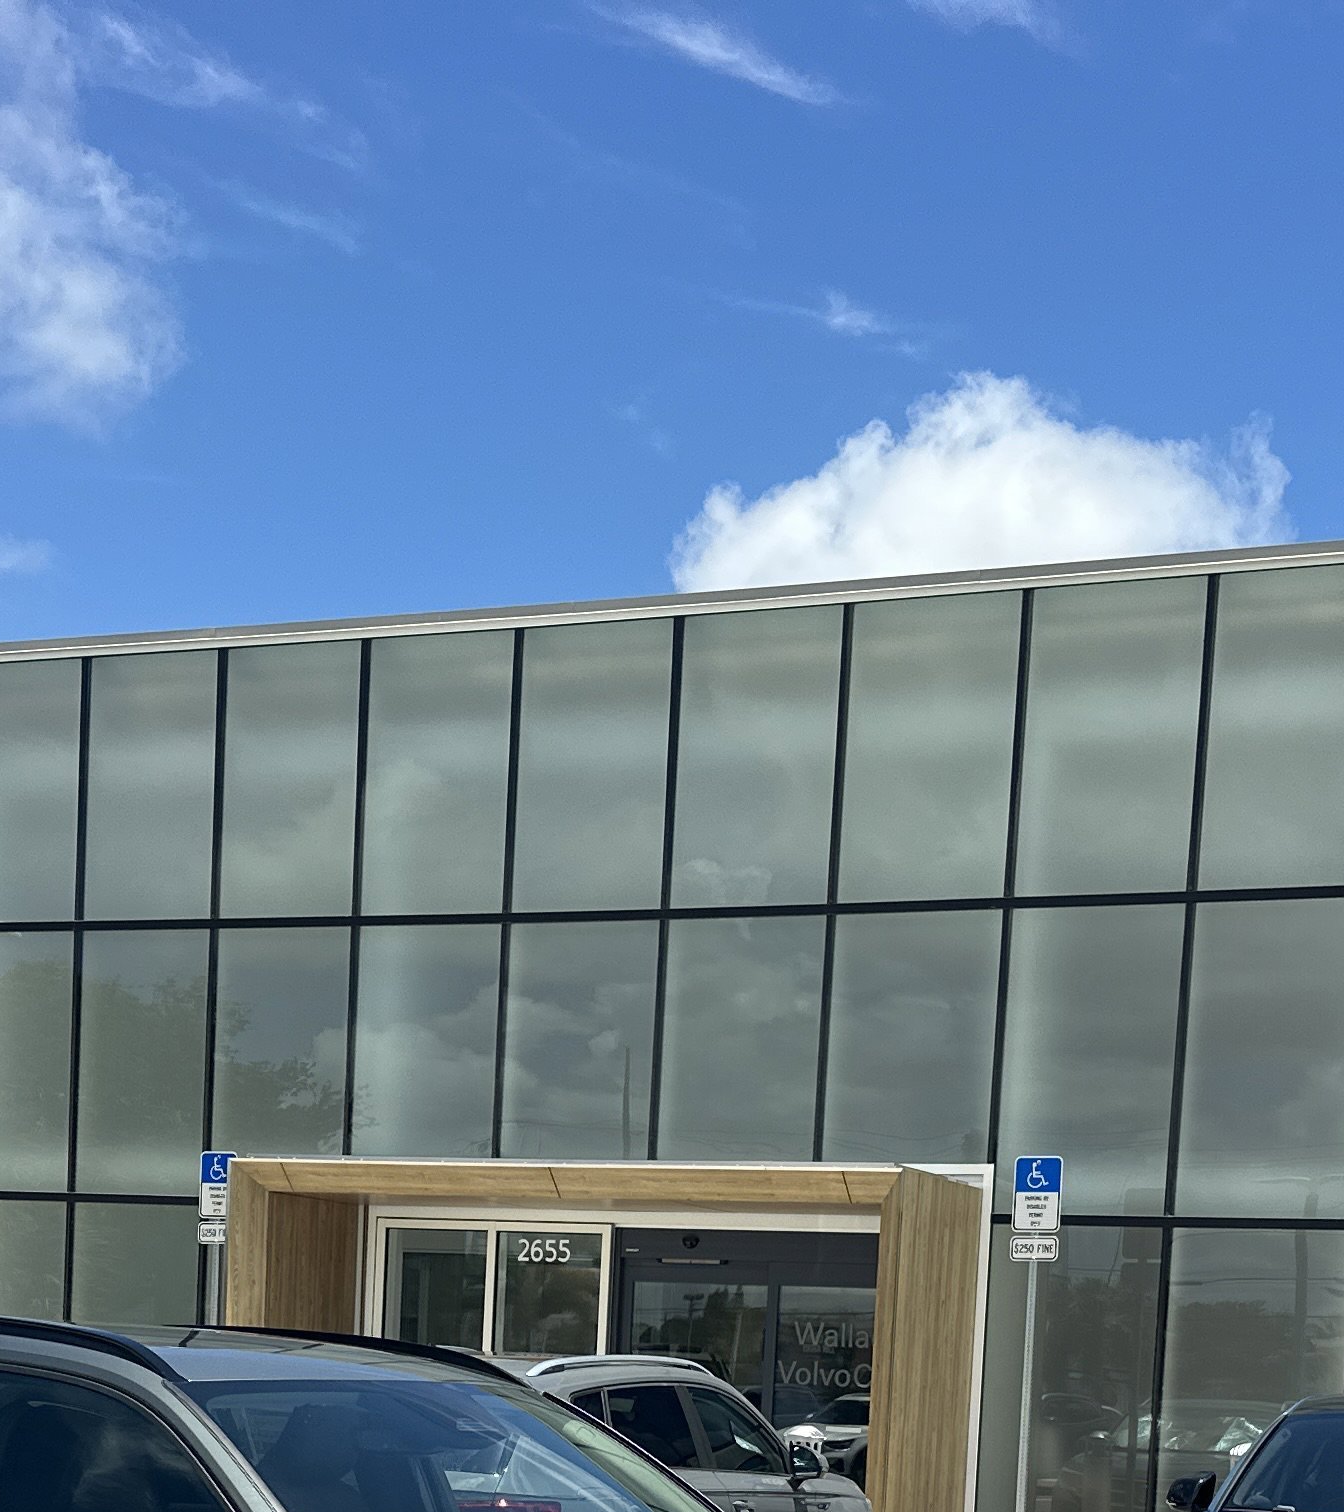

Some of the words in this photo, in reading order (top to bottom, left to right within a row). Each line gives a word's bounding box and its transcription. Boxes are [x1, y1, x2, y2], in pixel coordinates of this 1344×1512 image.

[517, 1238, 571, 1263] 2655
[1014, 1243, 1035, 1254] $250
[1036, 1244, 1054, 1254] FINE
